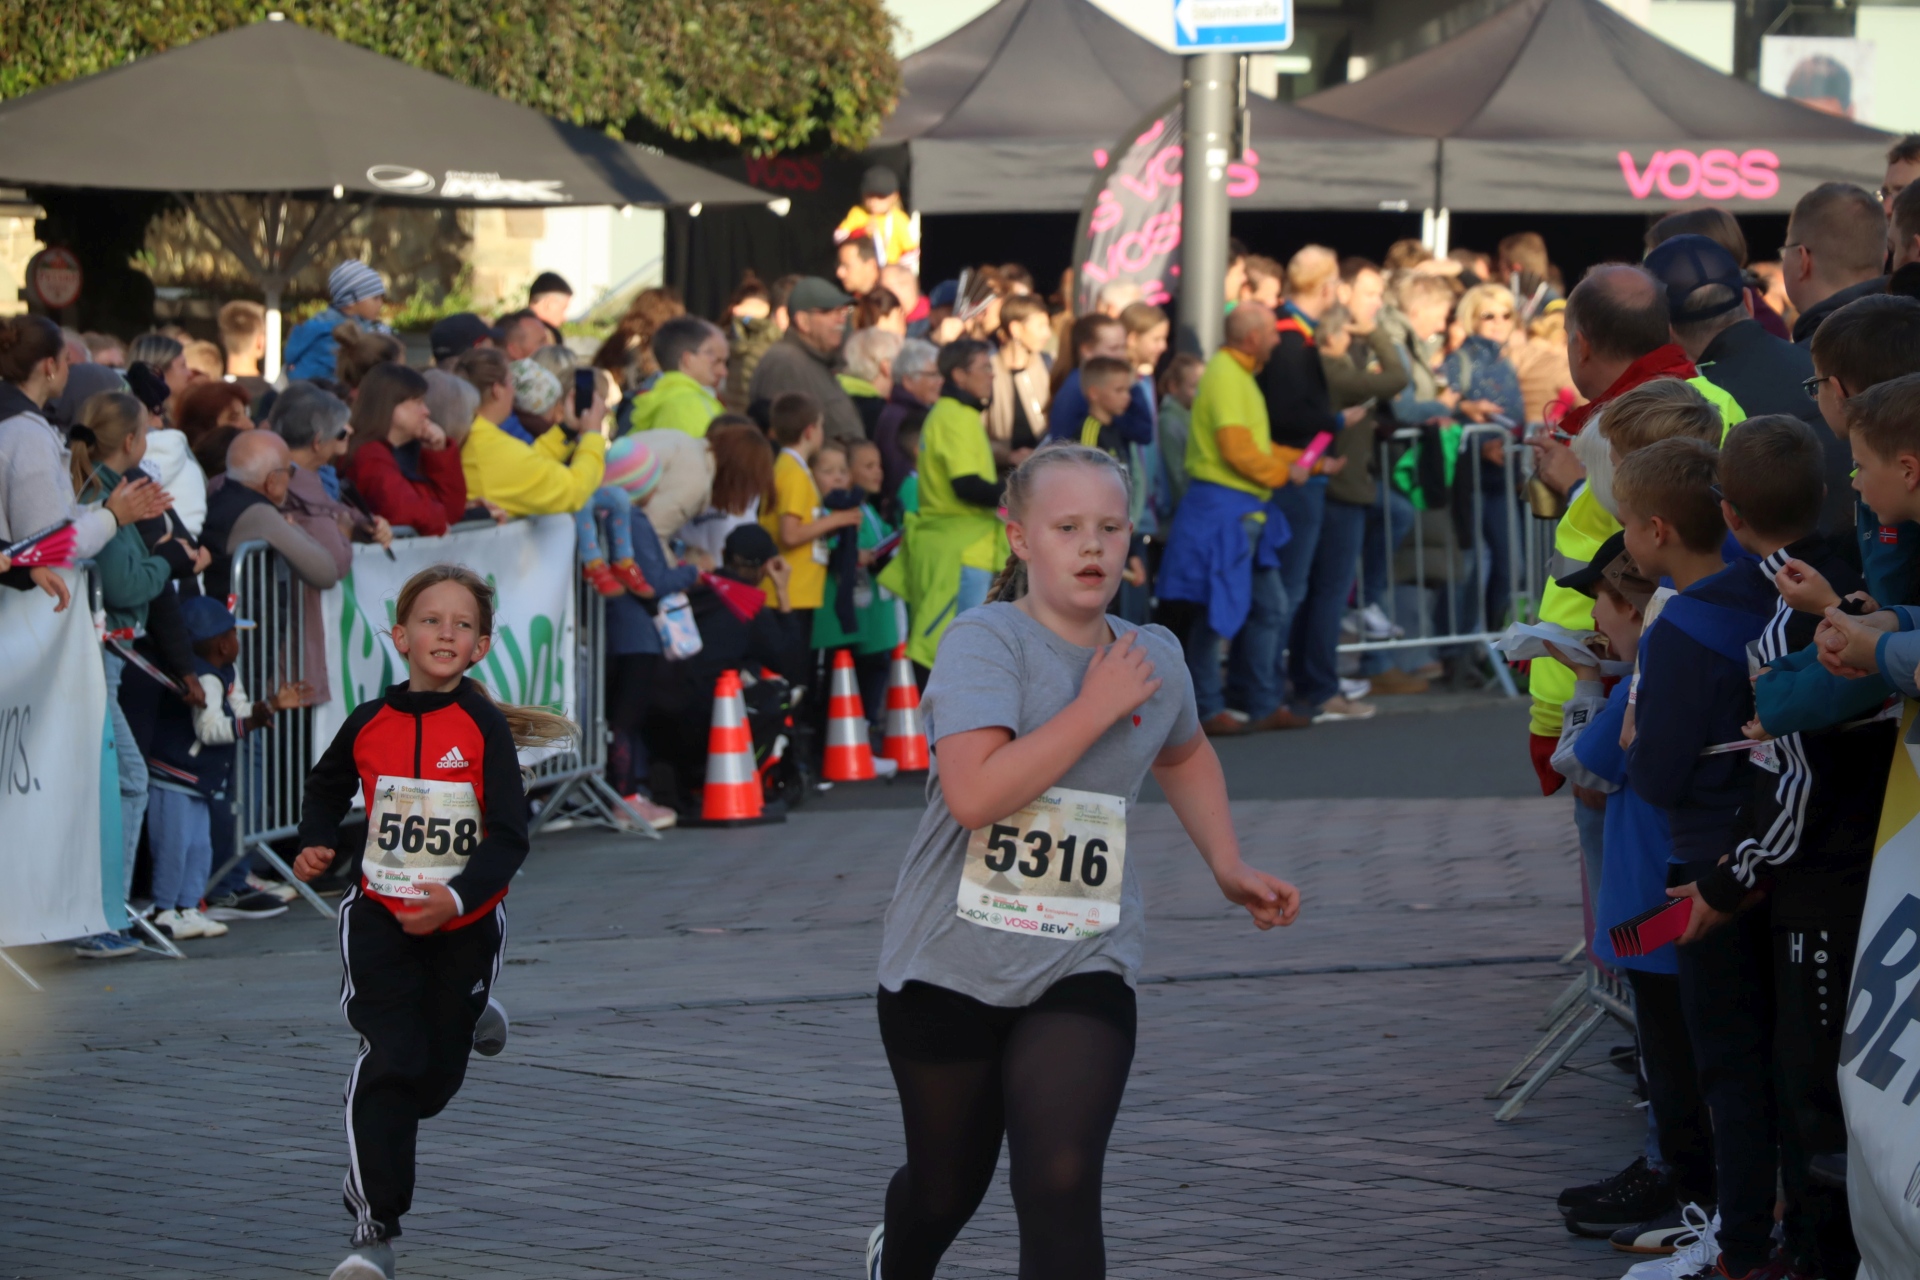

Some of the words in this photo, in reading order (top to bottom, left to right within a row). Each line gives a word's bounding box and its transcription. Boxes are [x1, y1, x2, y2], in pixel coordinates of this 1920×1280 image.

[1617, 149, 1780, 200] VOSS
[1752, 750, 1765, 762] OSS
[436, 760, 469, 769] adidas
[401, 785, 431, 795] Stadtlauf
[1036, 795, 1062, 805] dtlauf
[377, 812, 478, 856] 5658
[984, 823, 1109, 887] 5316
[393, 885, 422, 896] VOSS
[966, 908, 990, 922] AOK
[1004, 915, 1039, 931] VOSS
[1041, 922, 1069, 935] BEW
